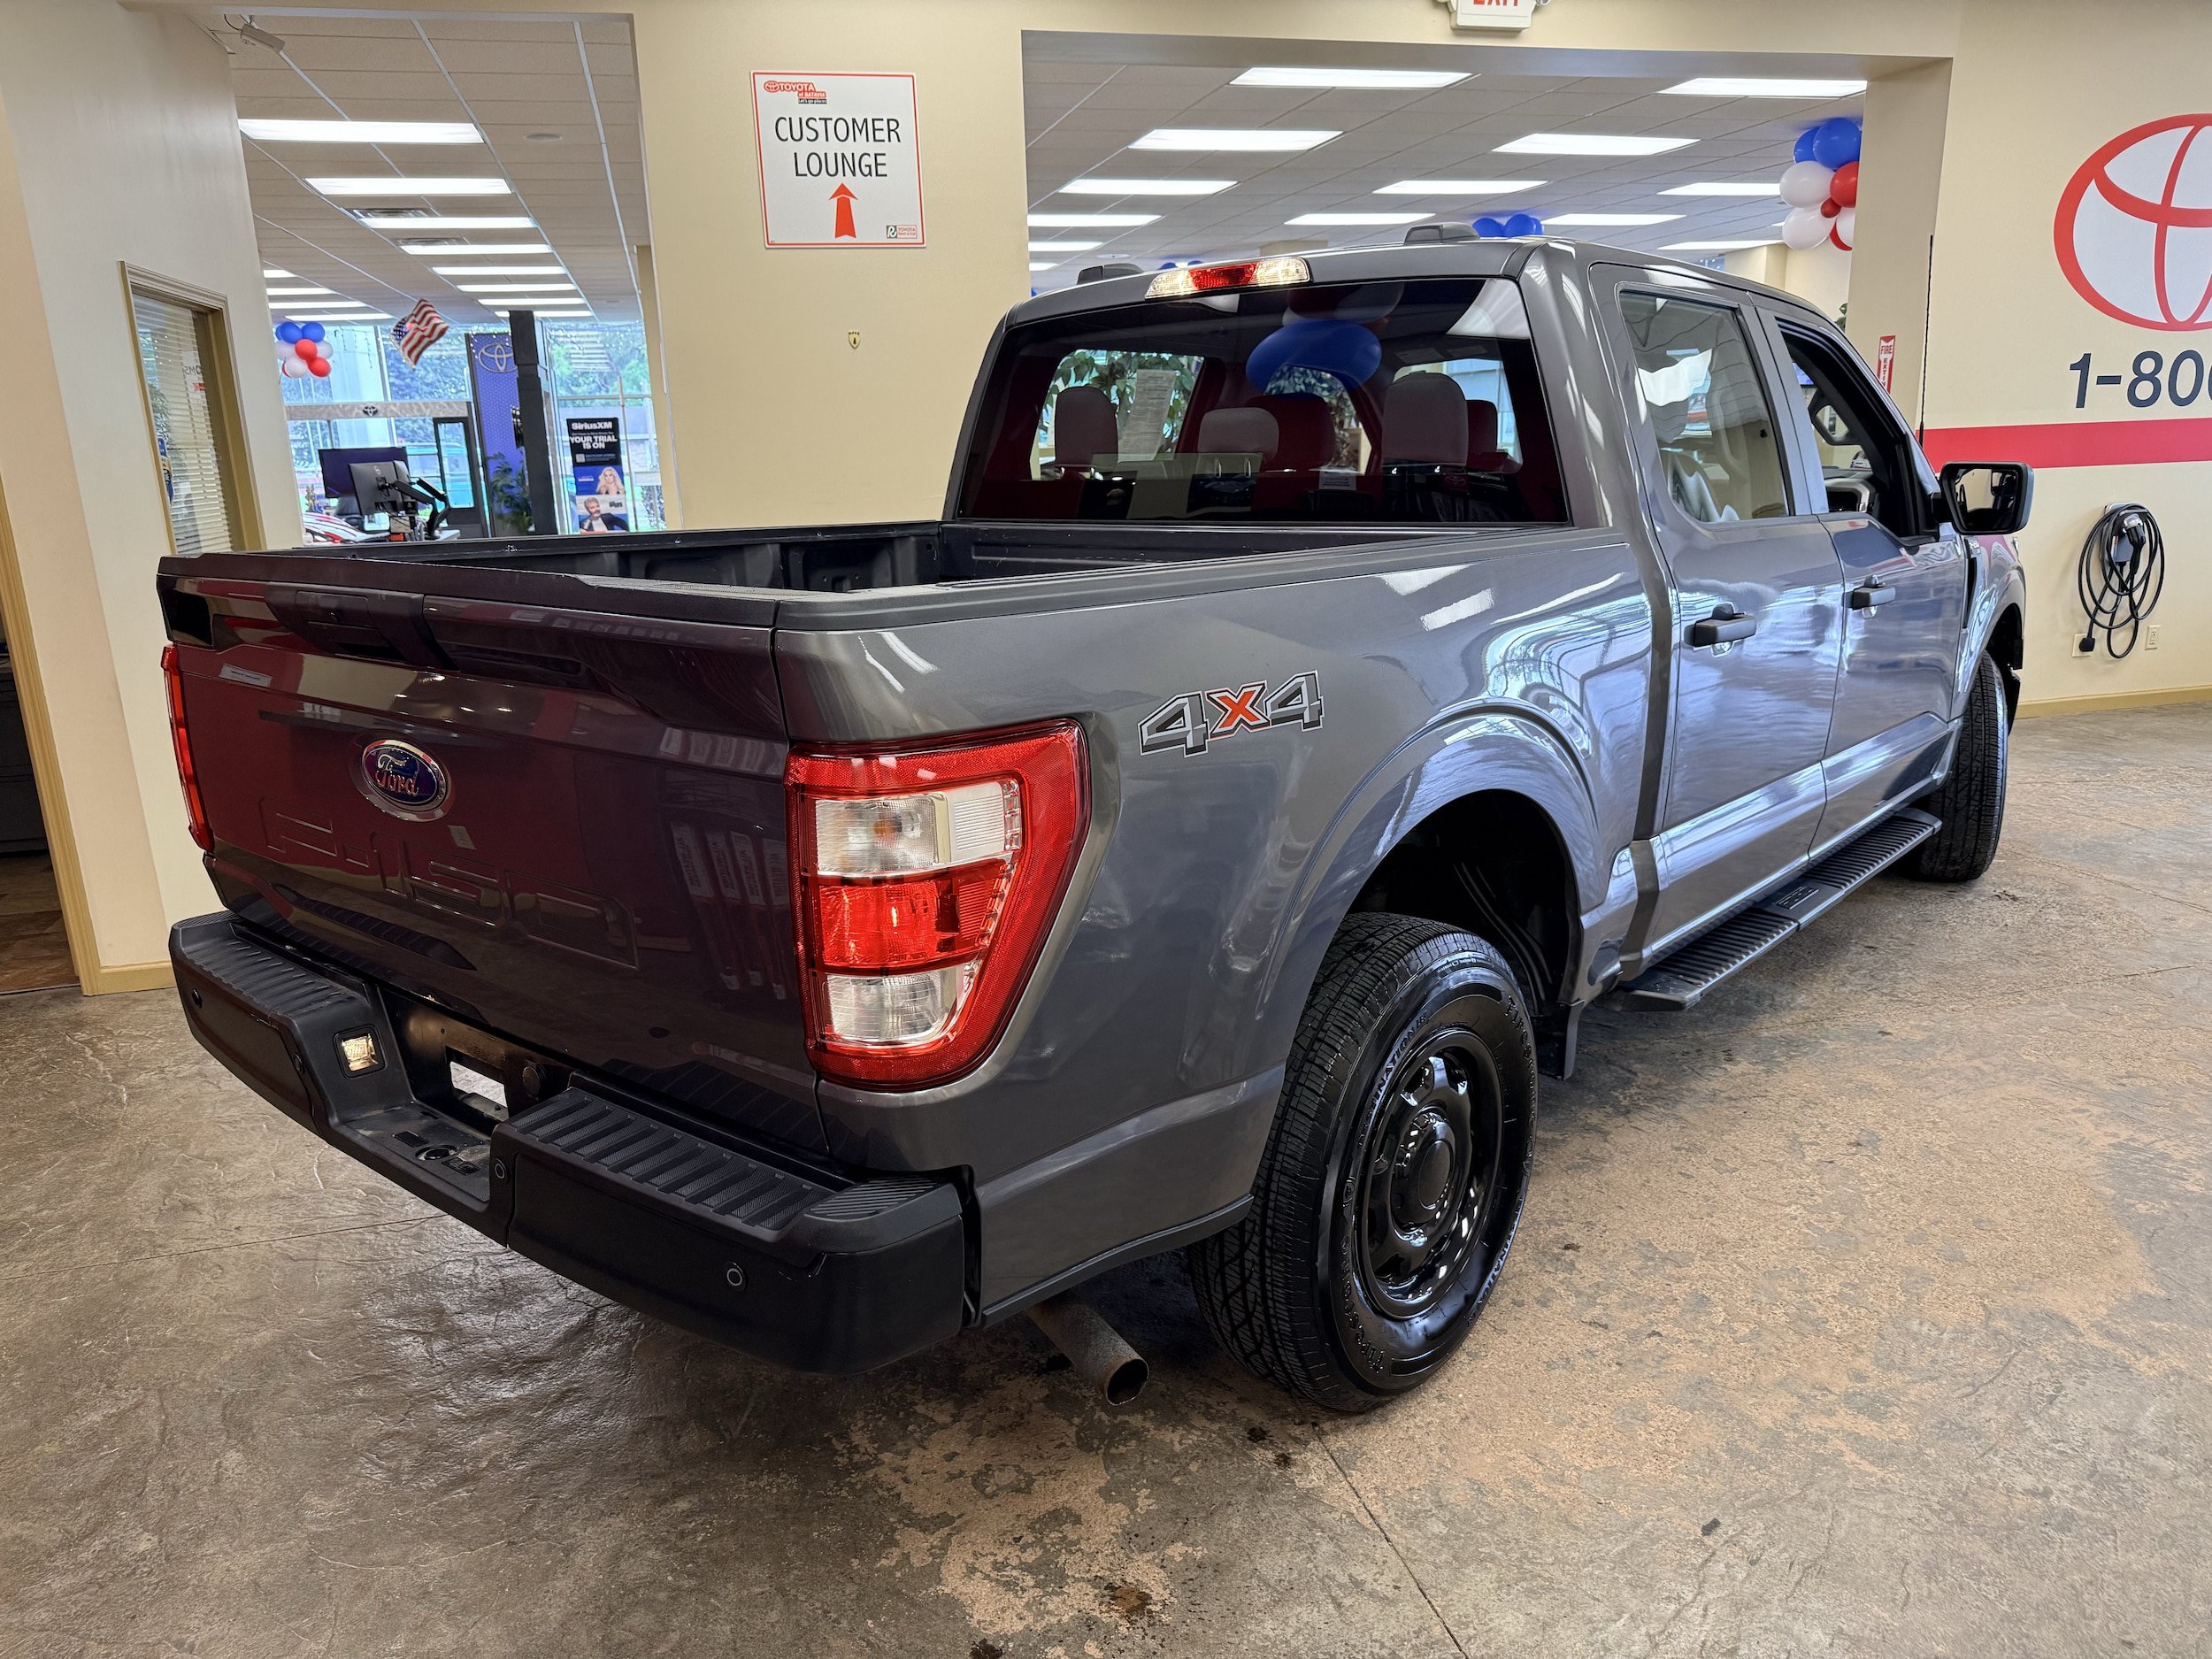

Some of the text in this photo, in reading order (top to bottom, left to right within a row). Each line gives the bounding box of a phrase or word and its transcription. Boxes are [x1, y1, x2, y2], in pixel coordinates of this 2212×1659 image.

[779, 82, 815, 92] TOYOTA
[774, 116, 902, 143] CUSTOMER
[794, 151, 887, 178] LOUNGE
[1881, 345, 1893, 354] FIRE
[2069, 349, 2212, 408] 1-80
[571, 421, 613, 430] SiriusXM
[375, 753, 419, 796] Ford
